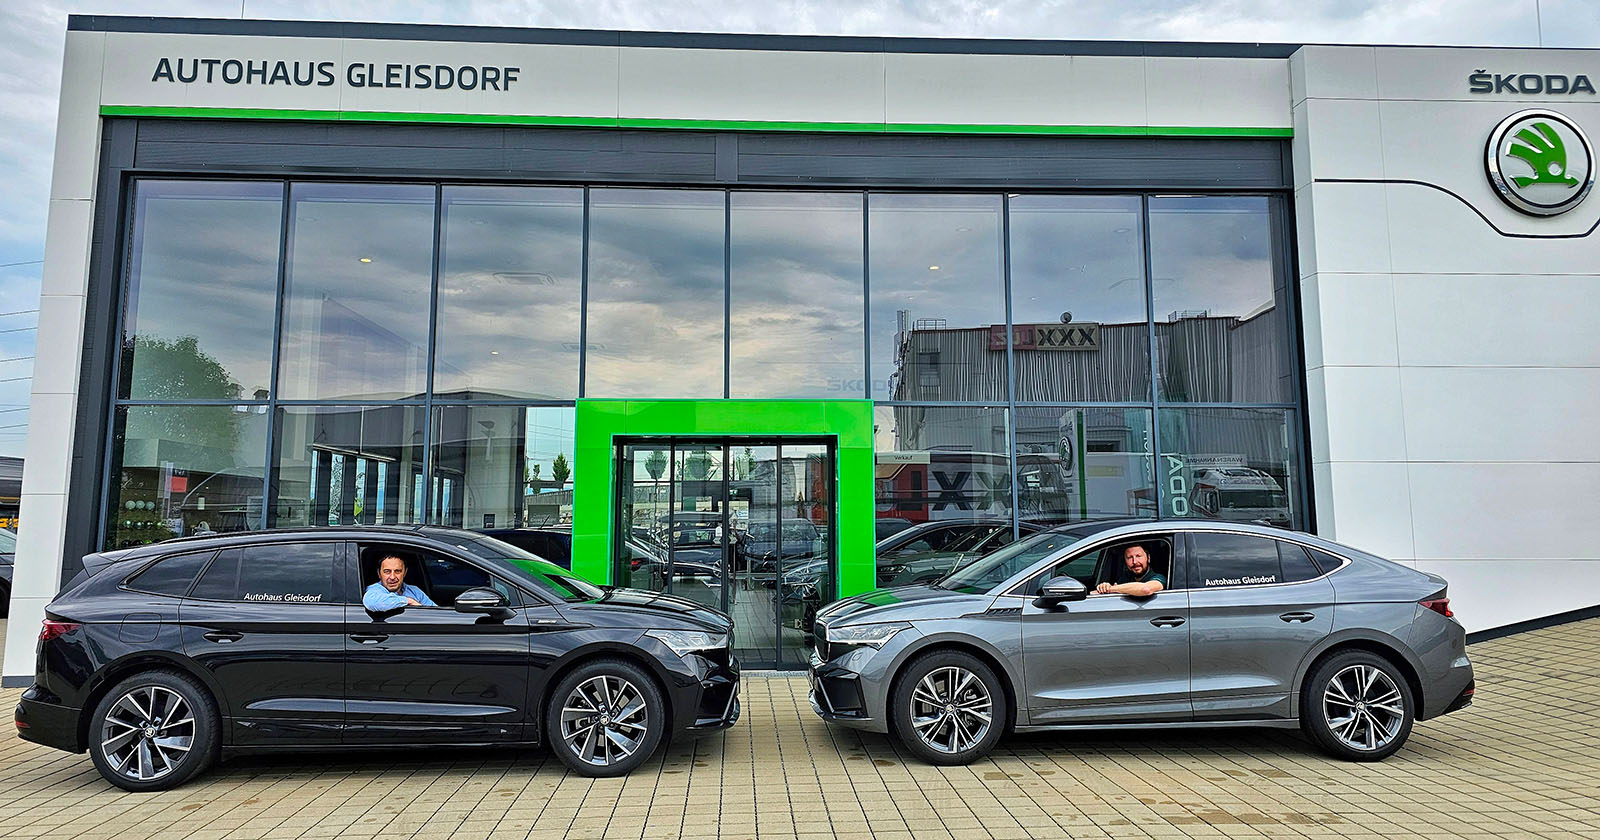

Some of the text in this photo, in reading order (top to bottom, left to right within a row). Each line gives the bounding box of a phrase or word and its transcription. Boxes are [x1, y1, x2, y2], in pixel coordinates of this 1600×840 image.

[151, 57, 521, 92] AUTOHAUS GLEISDORF
[1469, 69, 1597, 95] ŠKODA
[1205, 575, 1276, 587] Autohaus Gleisdorf
[243, 592, 322, 602] Autohaus Gleisdorf
